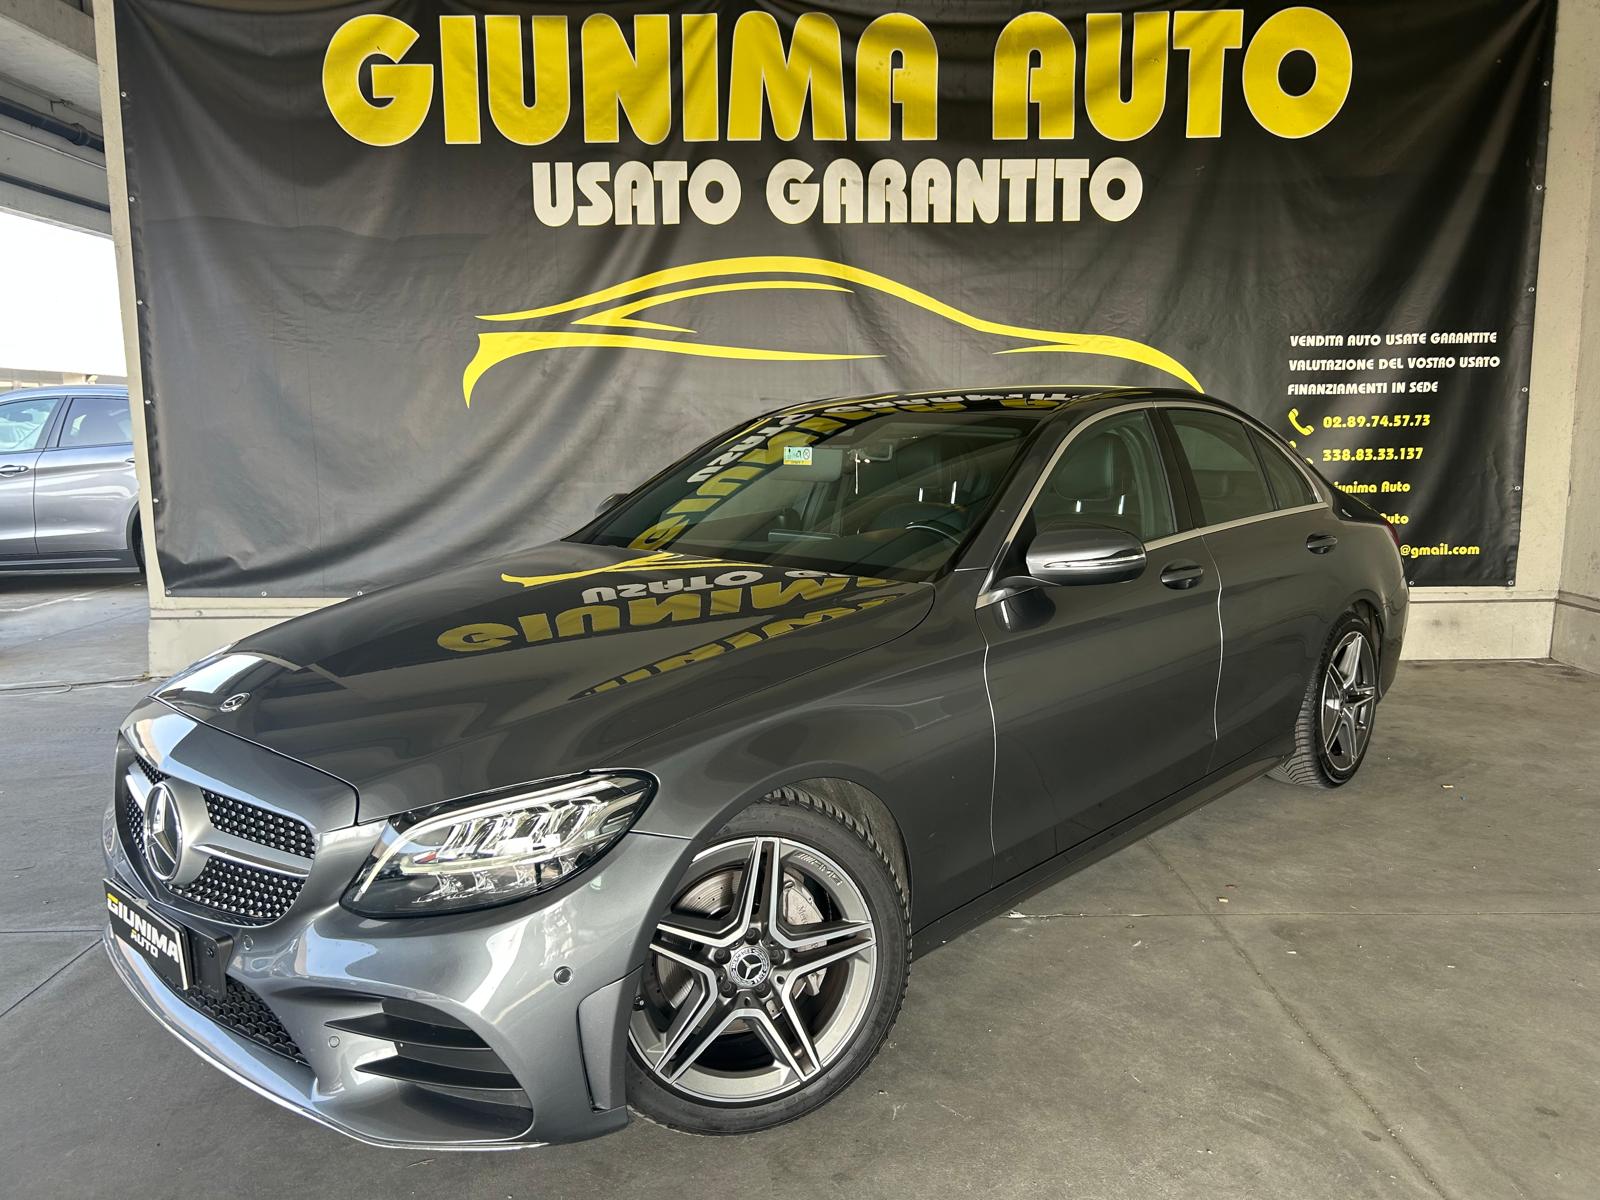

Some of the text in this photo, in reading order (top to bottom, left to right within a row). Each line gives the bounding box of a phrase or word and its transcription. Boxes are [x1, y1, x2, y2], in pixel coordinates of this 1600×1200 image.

[322, 6, 1353, 147] GIUNIMA AUTO
[532, 157, 1144, 228] USATO GARANTITO
[1289, 332, 1498, 347] VENDITA AUTO USATE GARANTITE
[1289, 356, 1501, 371] VALUTAZIONE DEL VOSTRO USATO
[1287, 381, 1439, 396] FINANZIAMENTI IN SEDE
[1323, 414, 1431, 429] 02.89.74.57.73
[1322, 447, 1424, 462] 338.83.33.137
[1334, 480, 1411, 494] iunima Auto
[106, 892, 180, 964] GIUNIMA
[130, 929, 158, 958] AUTO
